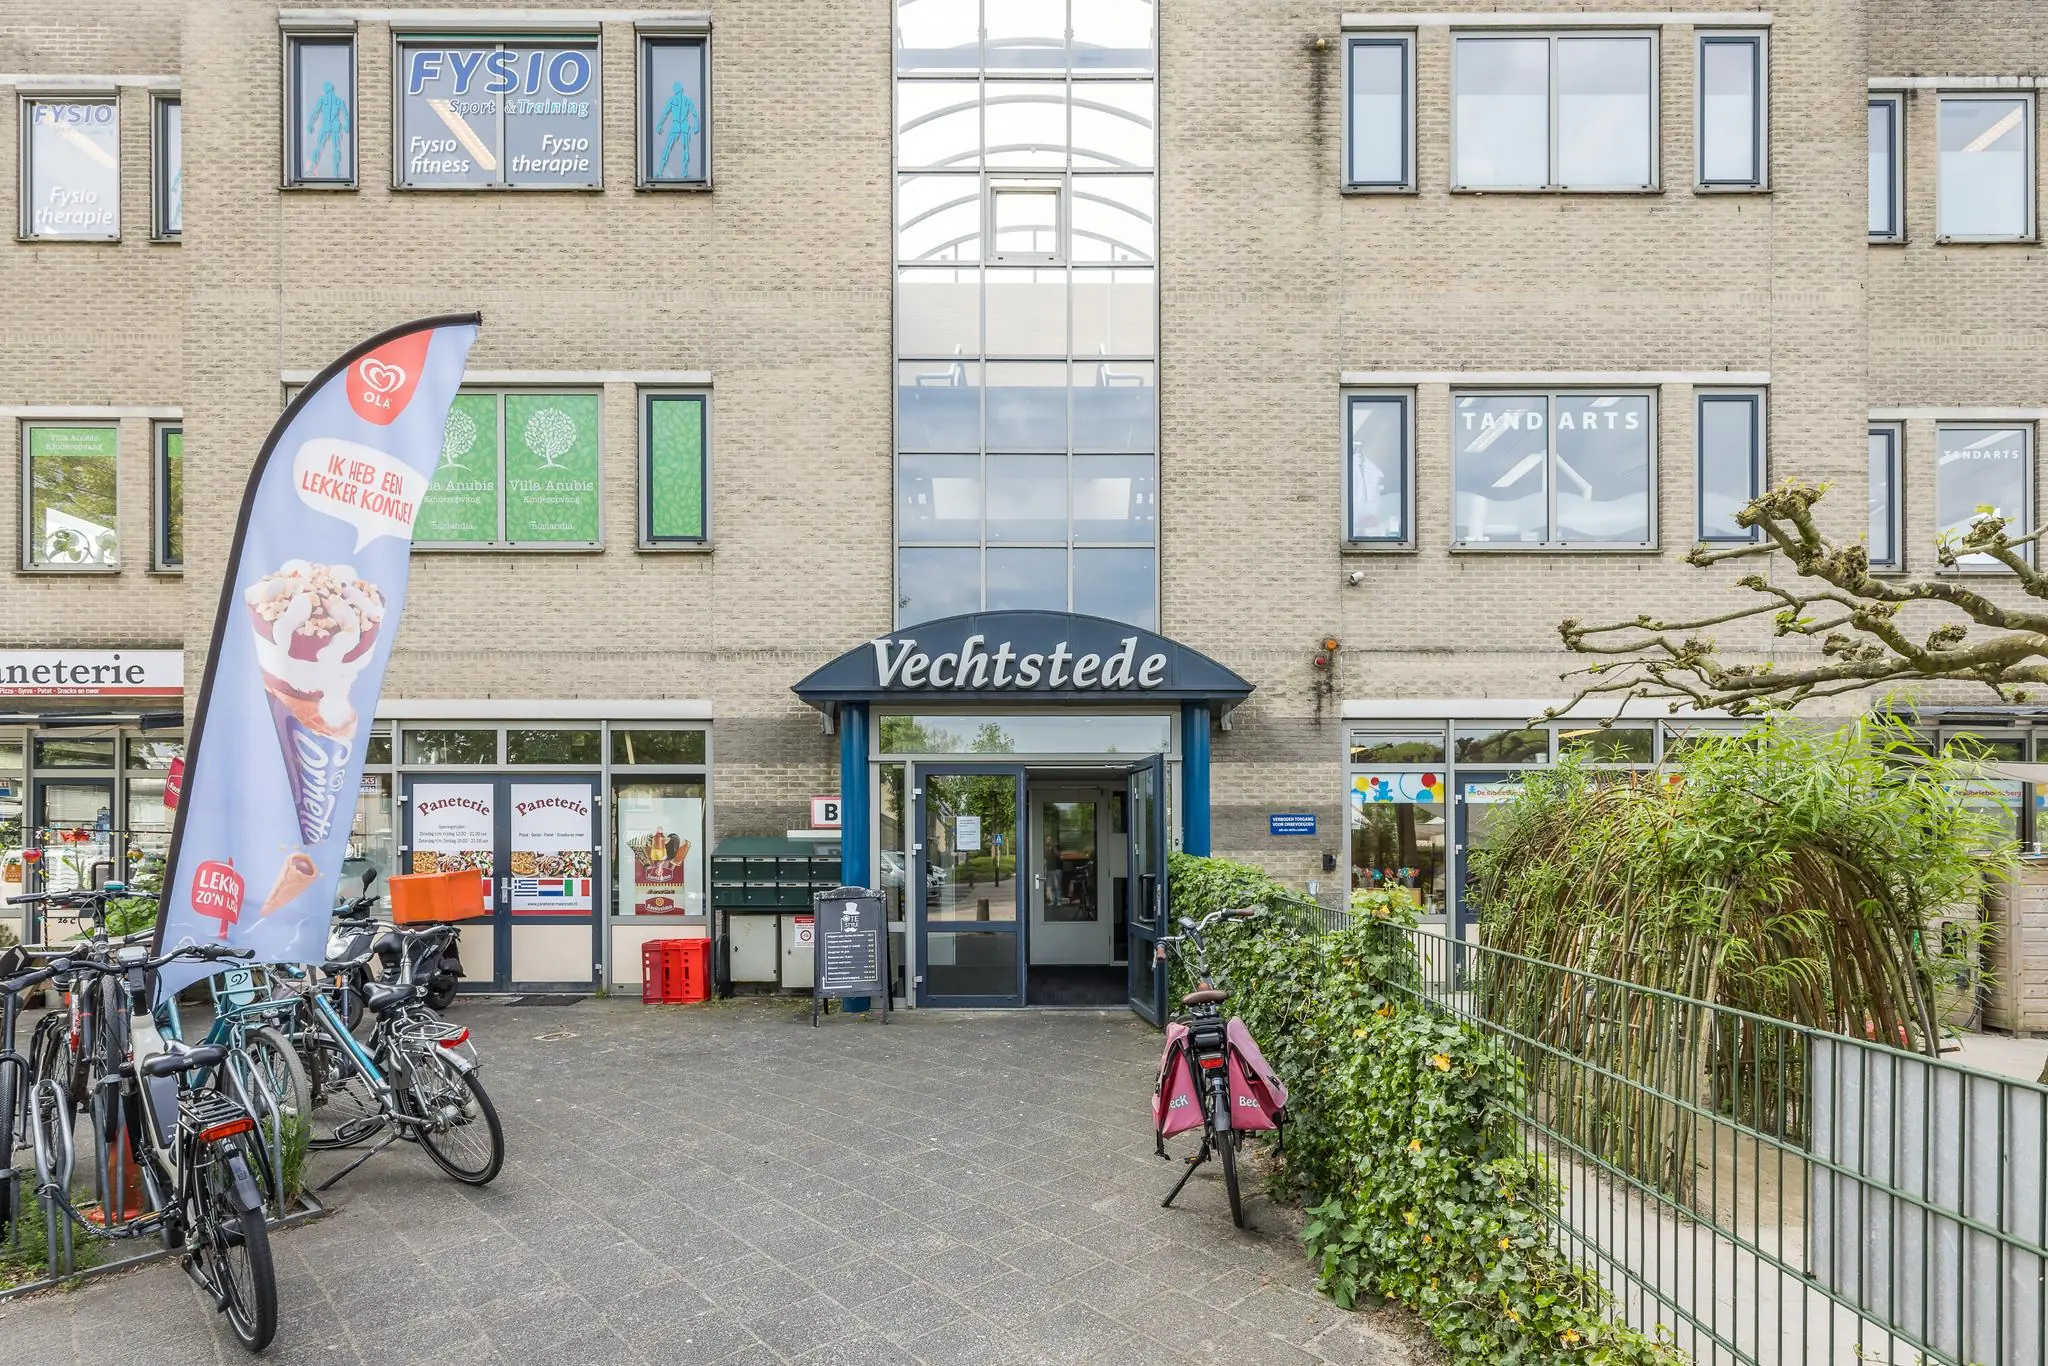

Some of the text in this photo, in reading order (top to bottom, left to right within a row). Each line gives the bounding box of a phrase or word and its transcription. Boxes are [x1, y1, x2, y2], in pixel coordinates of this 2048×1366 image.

[408, 50, 592, 96] FYSIO
[34, 104, 113, 125] FYSIO
[449, 99, 590, 118] Sport & Training
[410, 136, 457, 156] Fysio
[541, 134, 589, 156] Fysio
[410, 157, 470, 174] fitness
[512, 154, 590, 175] therapie
[50, 186, 97, 207] Fysio
[35, 207, 113, 228] therapie
[364, 391, 391, 409] OLA
[1944, 450, 2019, 460] TANDARTS
[328, 454, 403, 496] IK HEB EEN
[446, 479, 494, 491] Anubis
[509, 479, 594, 492] Villa Anubis
[302, 470, 413, 525] LEKKER KONTJE!
[870, 634, 1167, 690] Vechtstede
[417, 797, 490, 817] Paneterie
[515, 797, 588, 817] Paneterie
[825, 803, 839, 821] B
[196, 890, 224, 907] ZO'N
